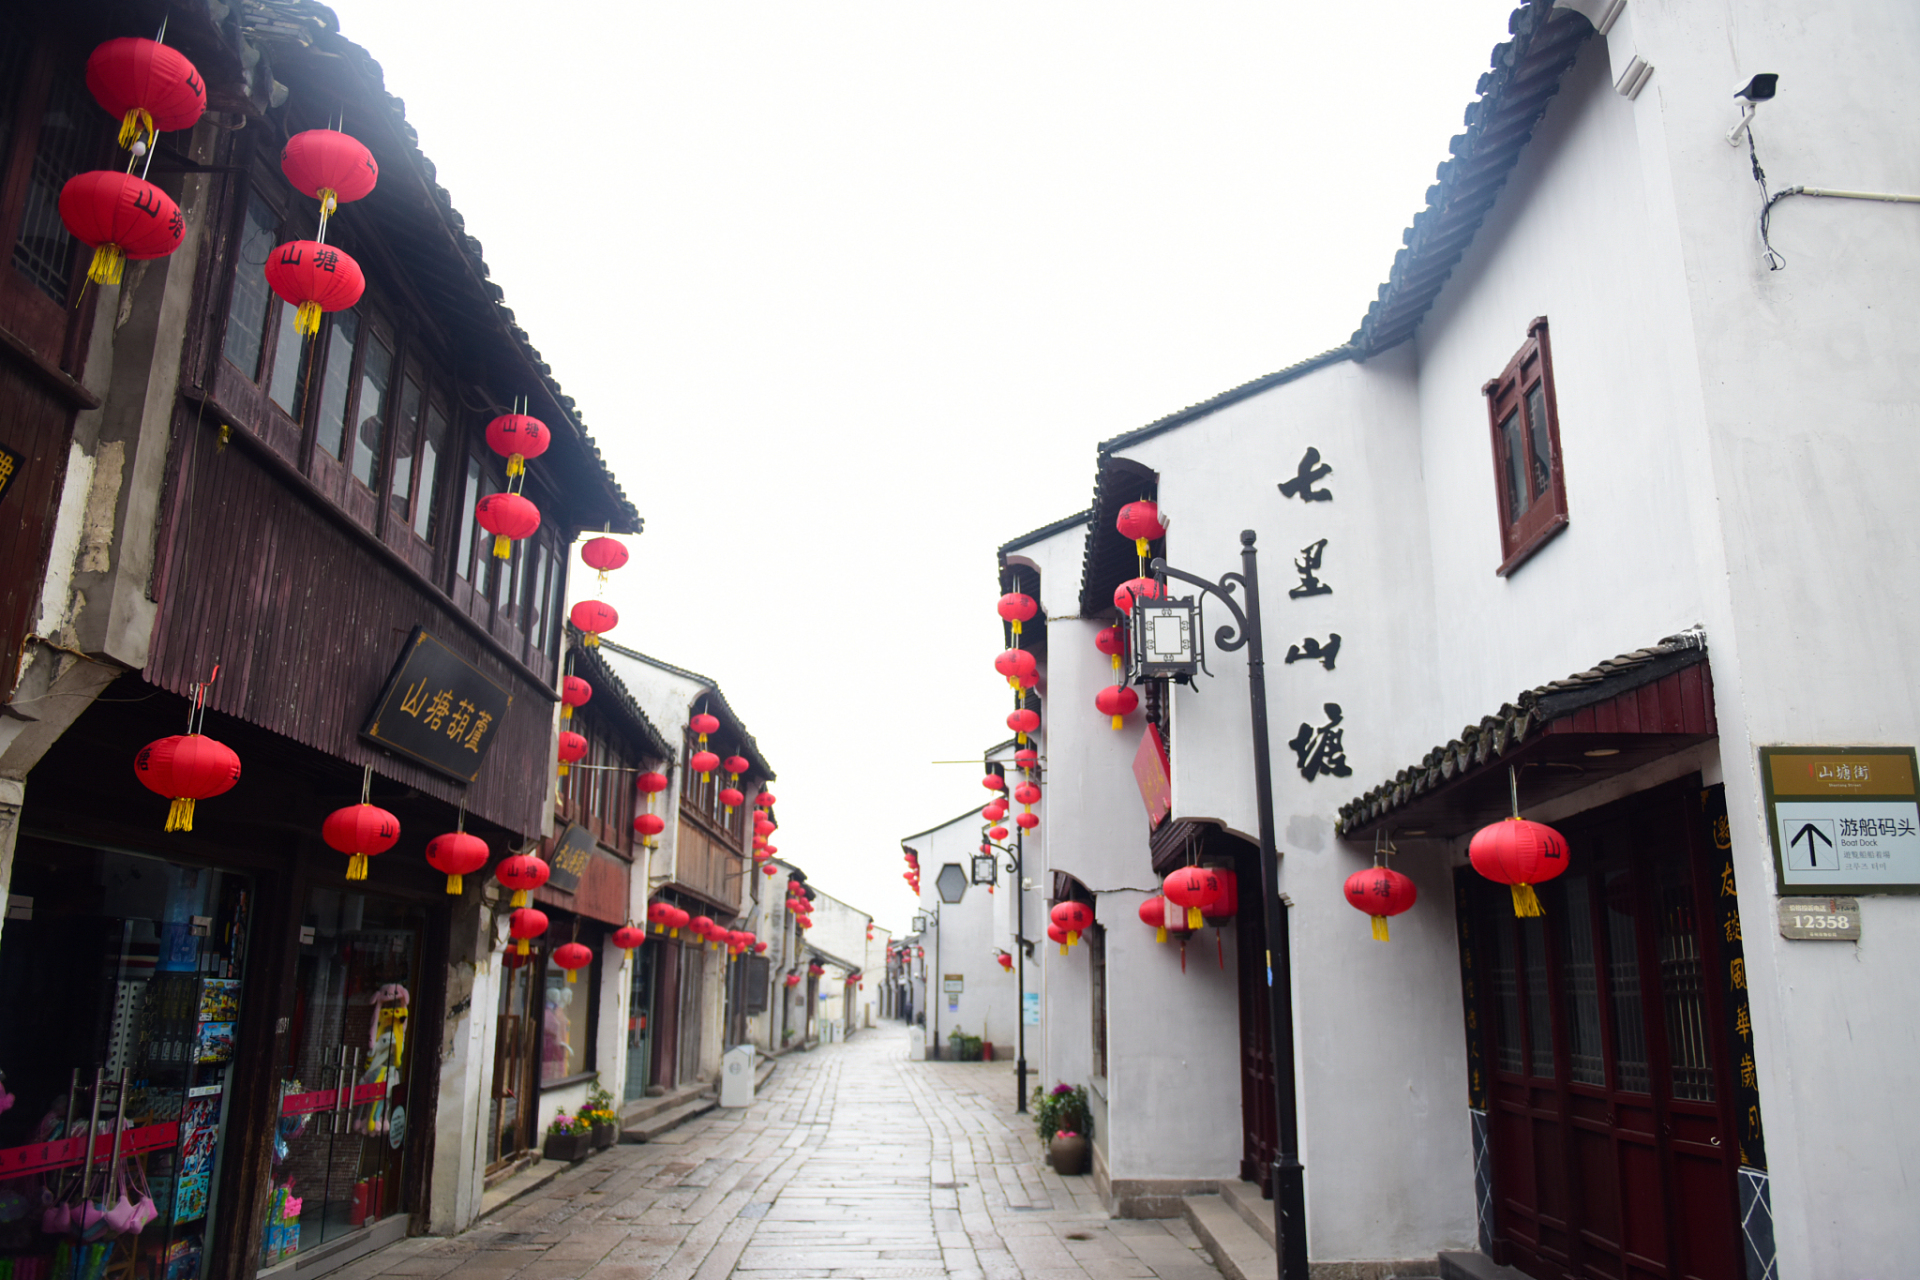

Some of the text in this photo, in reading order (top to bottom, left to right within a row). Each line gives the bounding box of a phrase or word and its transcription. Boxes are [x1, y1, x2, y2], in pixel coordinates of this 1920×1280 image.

[134, 189, 184, 239] 山塘
[281, 246, 339, 273] 山塘
[503, 418, 539, 439] 山塘
[1277, 446, 1352, 783] 七里山塘
[1818, 763, 1869, 781] 山塘街
[1839, 817, 1916, 837] 游船码头
[1841, 839, 1878, 847] Boat Dock
[508, 864, 538, 878] 山塘
[1186, 876, 1218, 891] 山塘
[1352, 879, 1391, 898] 山塘
[1793, 914, 1850, 929] 12358
